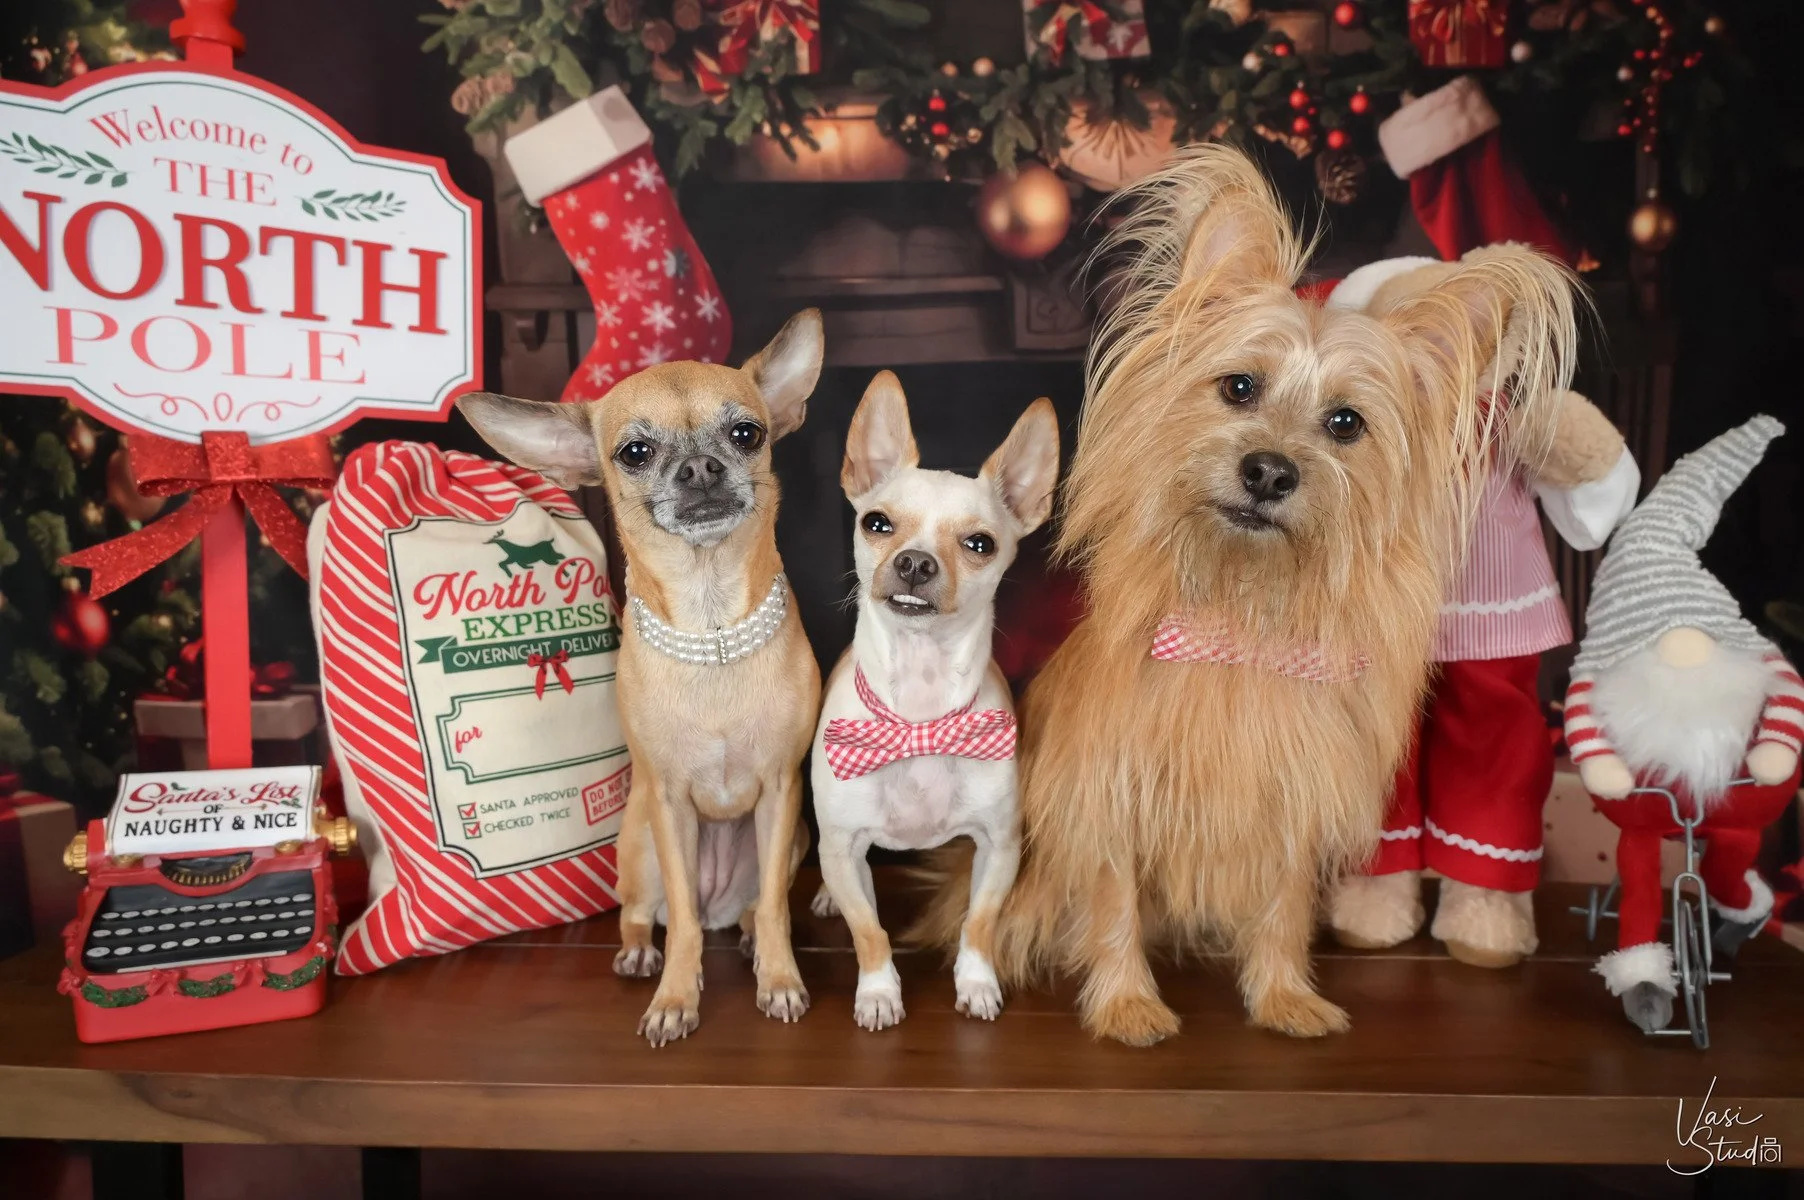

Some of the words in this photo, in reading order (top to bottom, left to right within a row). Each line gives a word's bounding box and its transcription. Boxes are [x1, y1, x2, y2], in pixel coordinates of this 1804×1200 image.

[88, 104, 267, 154] Welcome
[280, 142, 313, 176] to
[153, 157, 277, 207] THE
[0, 190, 448, 335] NORTH
[42, 306, 366, 384] POLE
[413, 569, 546, 620] North
[461, 602, 608, 642] EXPRESS
[452, 641, 551, 668] OVERNIGHT
[455, 726, 482, 753] for
[124, 782, 240, 813] Santa's
[241, 781, 302, 805] List
[203, 804, 223, 814] OF
[480, 799, 516, 814] SANTA
[523, 787, 579, 806] APPROVED
[124, 816, 224, 837] NAUGHTY
[231, 815, 245, 831] &
[254, 812, 298, 829] NICE
[484, 815, 534, 834] CHECKED
[539, 807, 571, 823] TWICE
